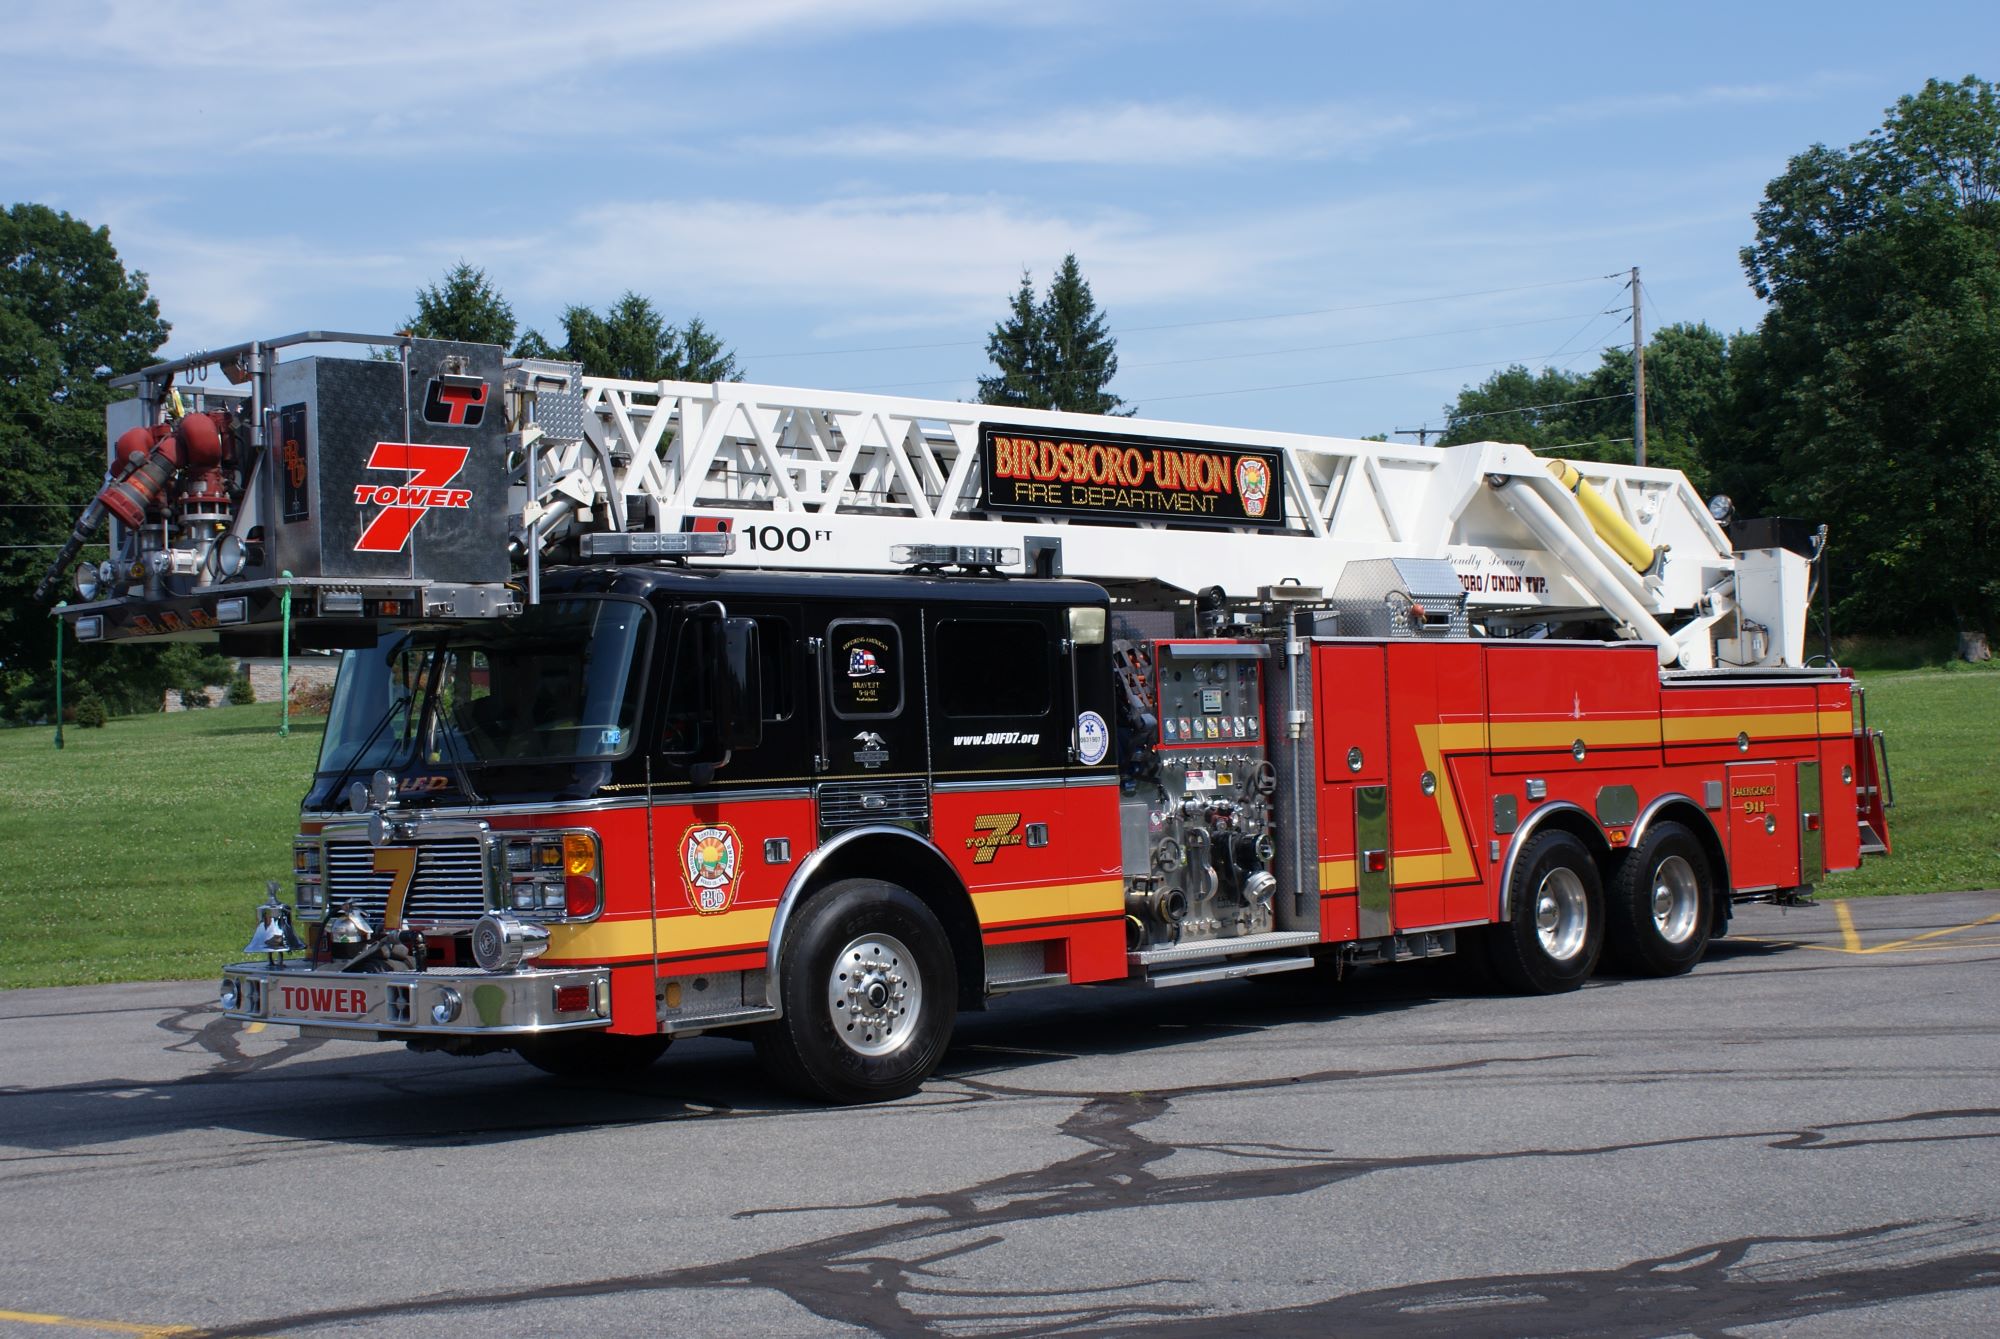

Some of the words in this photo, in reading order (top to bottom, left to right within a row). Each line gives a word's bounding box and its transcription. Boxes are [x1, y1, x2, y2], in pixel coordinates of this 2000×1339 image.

[994, 436, 1232, 494] BIRDSBORO-UNION
[353, 484, 473, 509] TOWER
[353, 442, 471, 552] 7
[1015, 482, 1062, 504] FIRE
[1072, 485, 1218, 513] DEPARTMENT
[742, 525, 811, 552] 100
[815, 530, 832, 541] FT
[1489, 554, 1527, 571] Serving
[953, 731, 1040, 746] www.BUFD7.org
[1731, 785, 1776, 797] EMERGENCY
[1743, 800, 1765, 814] 911
[965, 834, 1023, 849] TOWER
[973, 813, 1021, 864] 7
[373, 847, 418, 931] 7
[281, 986, 368, 1015] TOWER
